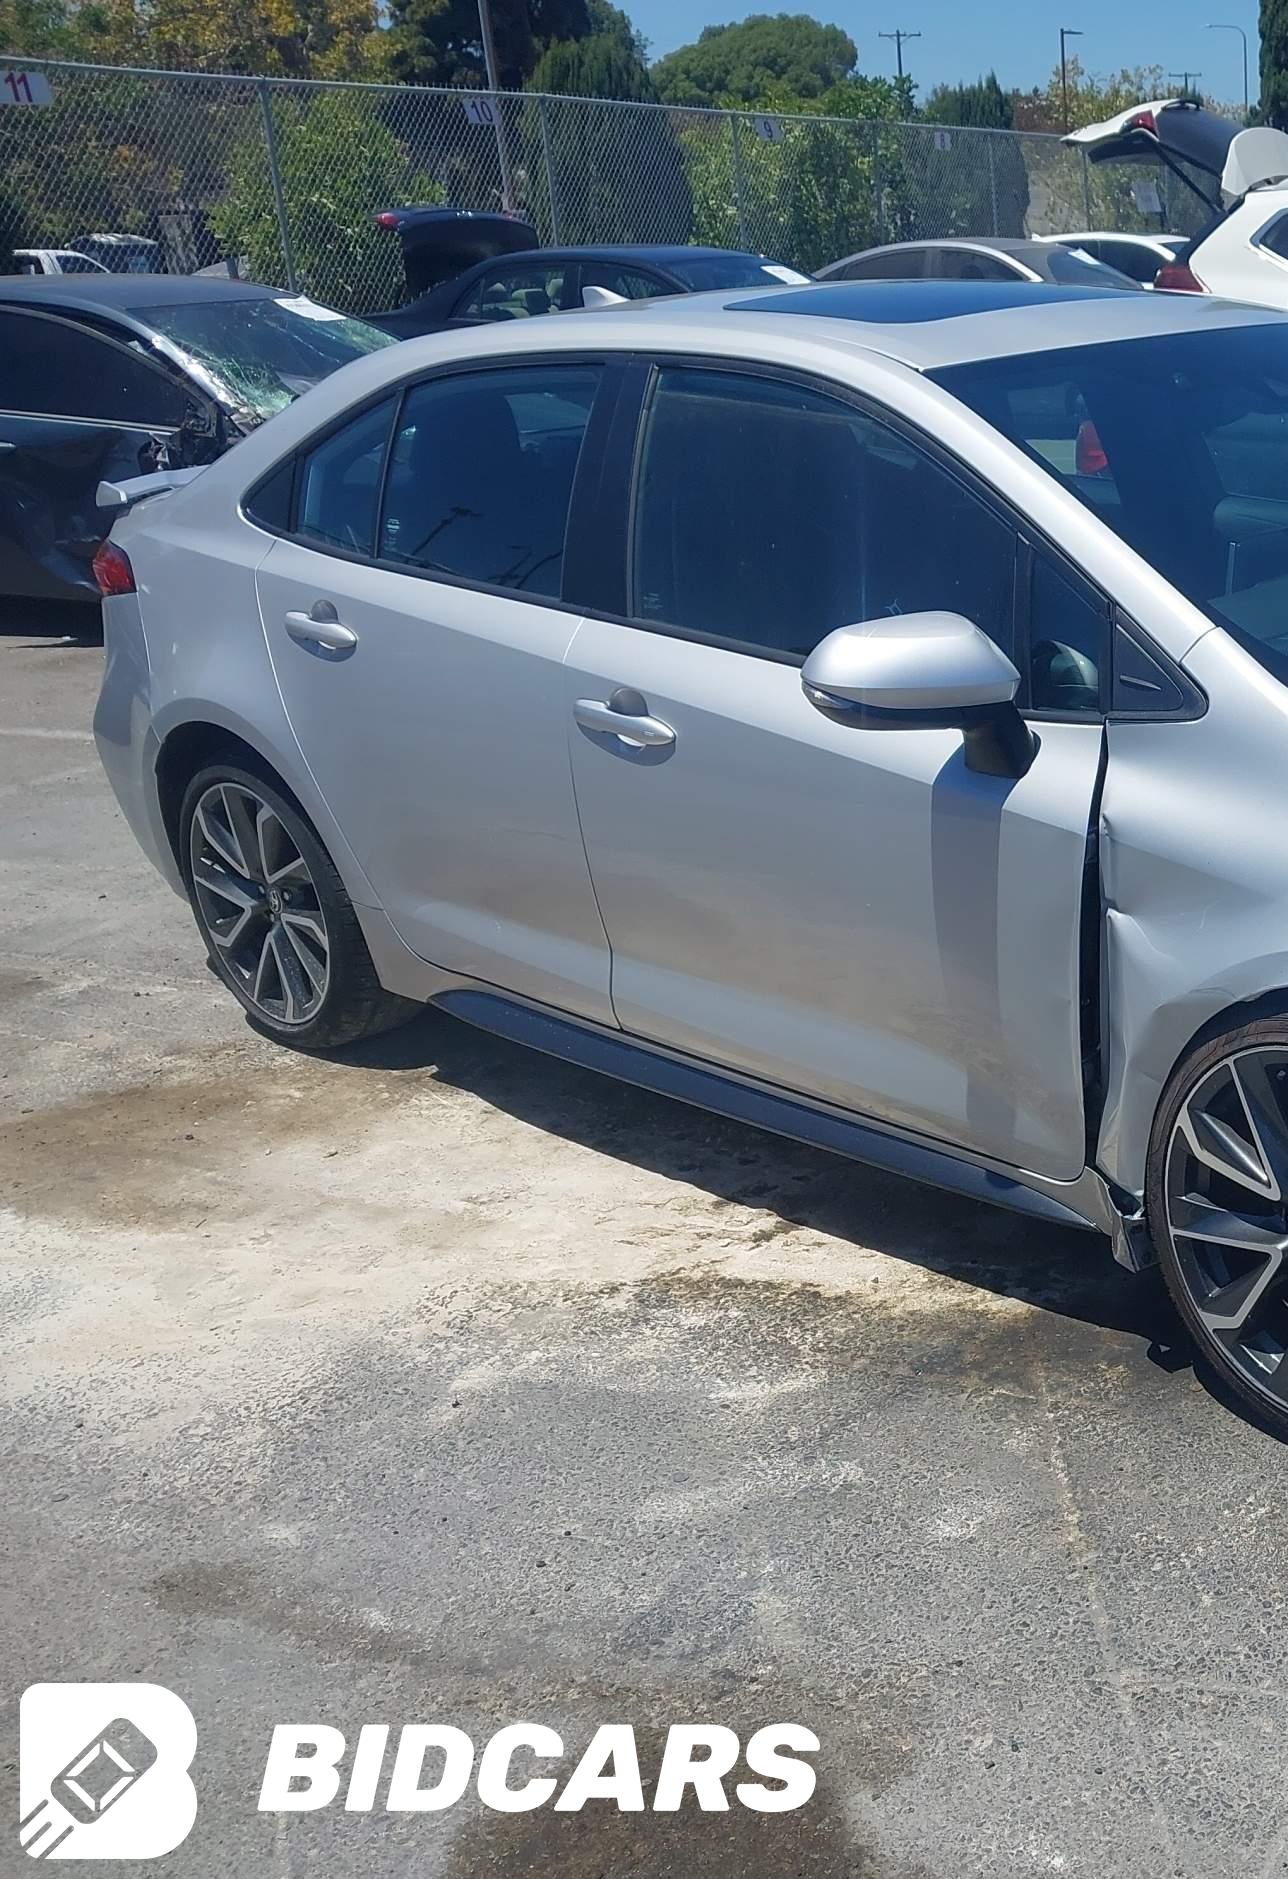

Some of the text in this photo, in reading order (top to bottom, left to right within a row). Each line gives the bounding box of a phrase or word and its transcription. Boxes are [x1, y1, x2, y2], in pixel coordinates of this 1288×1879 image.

[4, 71, 33, 103] 11
[471, 100, 494, 123] 10
[763, 121, 774, 139] 9
